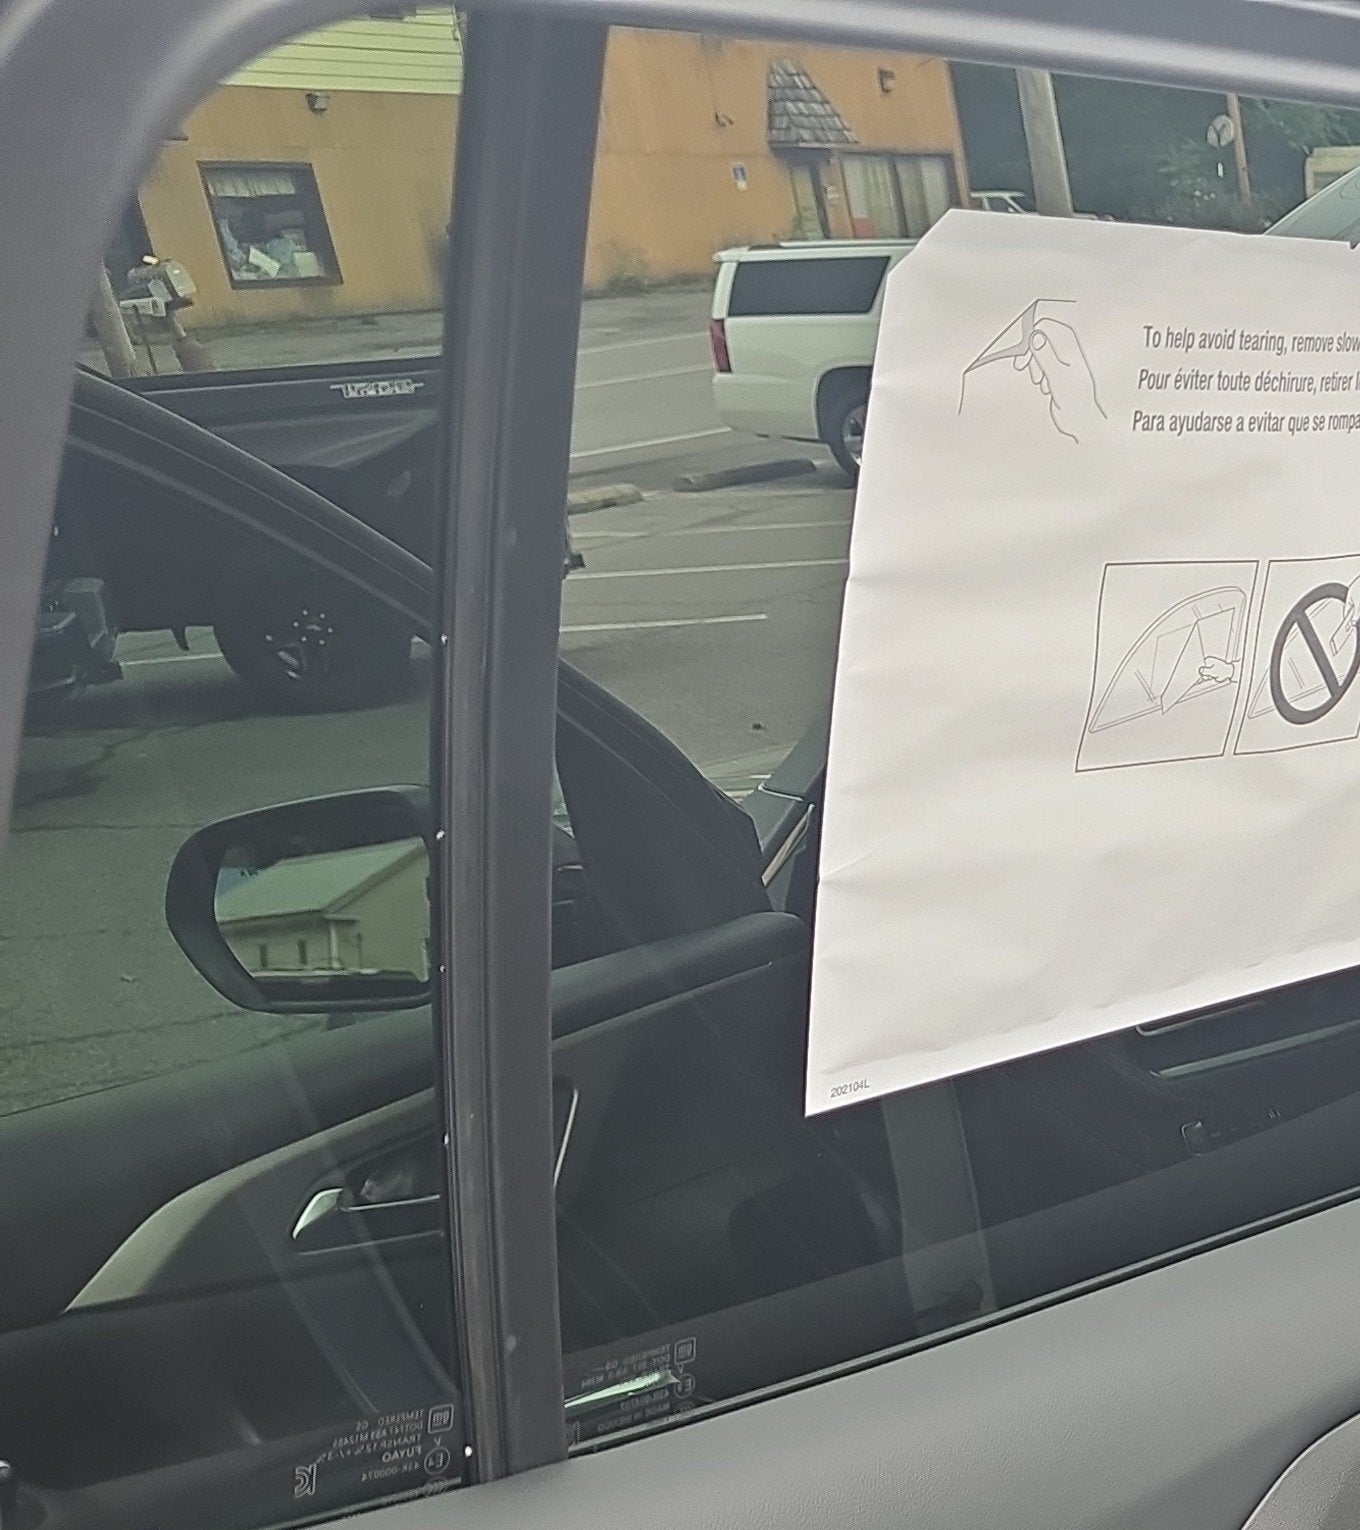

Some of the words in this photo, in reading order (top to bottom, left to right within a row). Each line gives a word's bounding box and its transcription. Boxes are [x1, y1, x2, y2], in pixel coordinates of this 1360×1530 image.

[1143, 326, 1161, 348] To
[1165, 326, 1195, 353] help
[1199, 329, 1236, 350] avoid
[1239, 330, 1287, 356] tearing,
[1292, 336, 1334, 352] remove
[1138, 369, 1171, 390] Pour
[1174, 367, 1214, 390] éviter
[1217, 370, 1251, 391] toute
[1255, 370, 1316, 395] déchirure,
[1320, 371, 1353, 392] retirer
[1133, 410, 1164, 431] Para
[1170, 411, 1232, 436] ayudarse
[1236, 416, 1244, 432] a
[1248, 412, 1285, 432] evitar
[1288, 416, 1309, 436] que
[1312, 415, 1325, 431] se
[830, 1078, 870, 1098] 202104L
